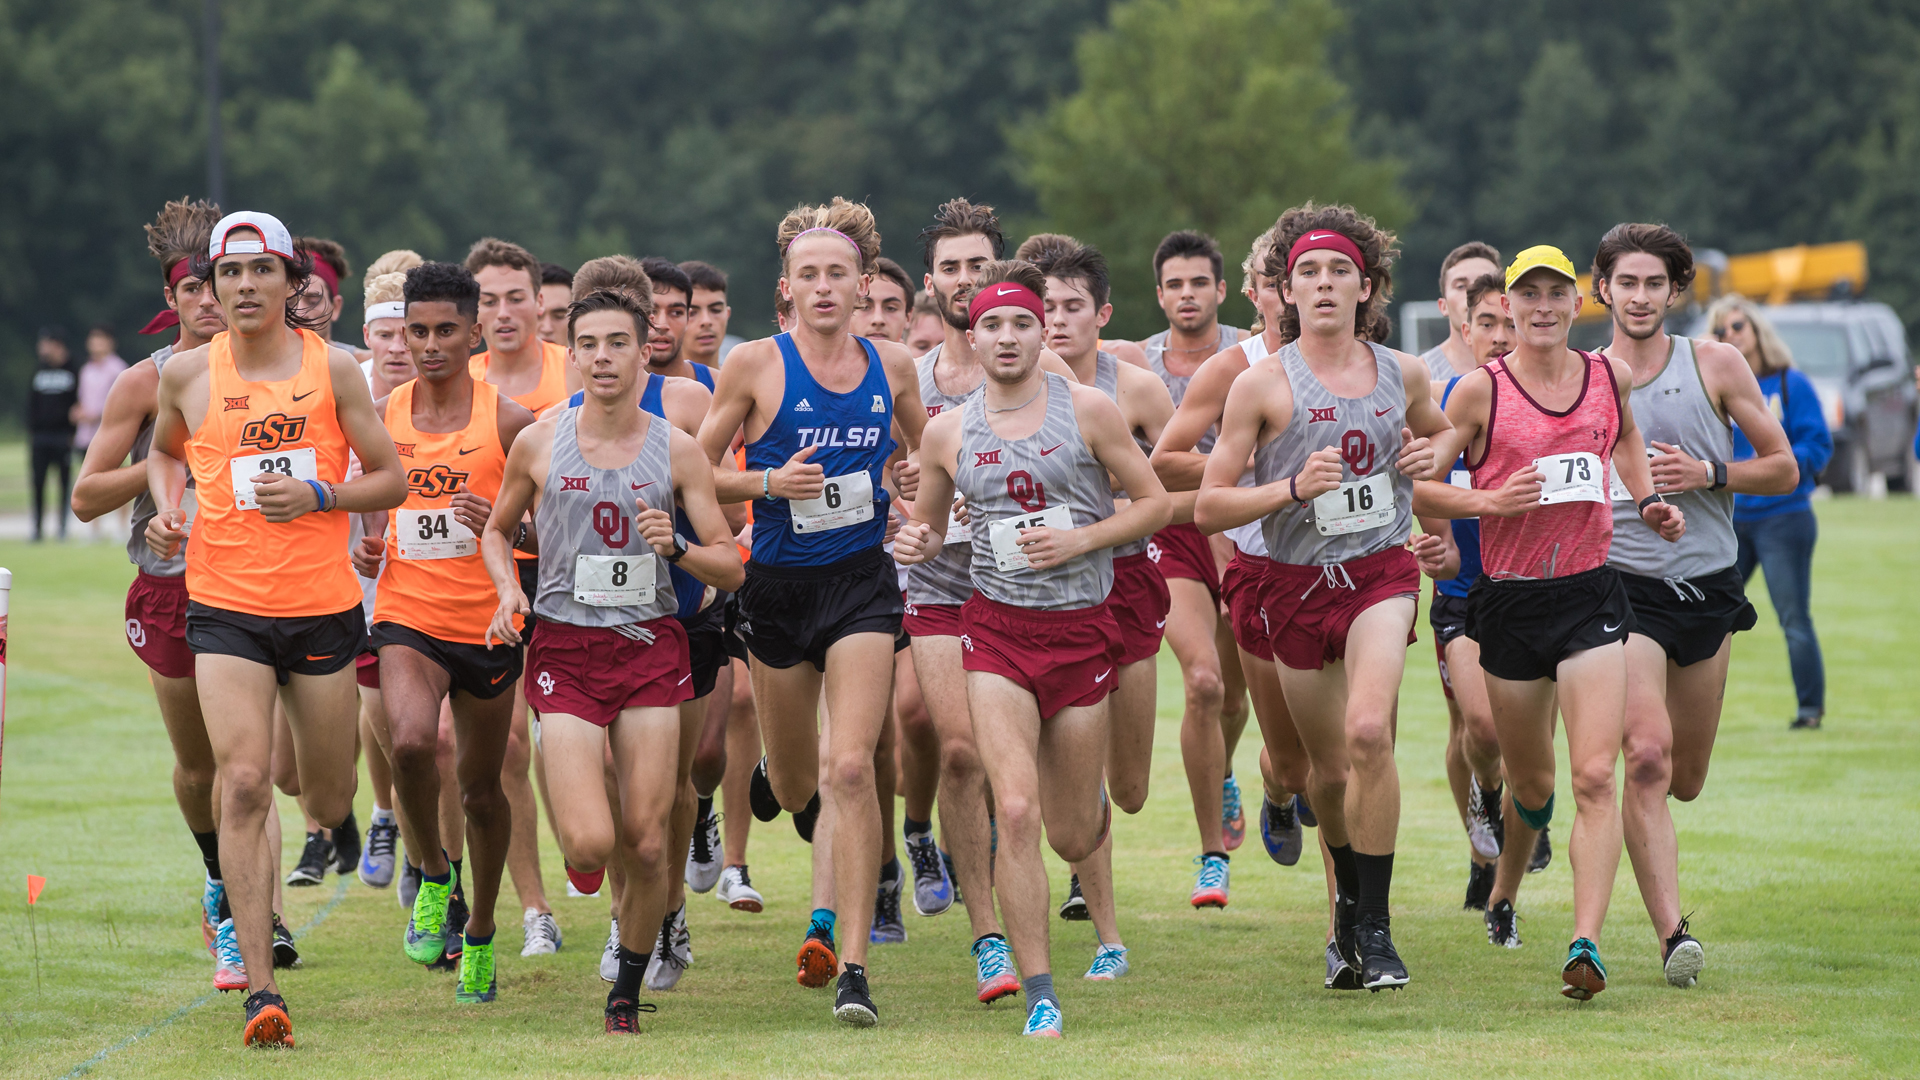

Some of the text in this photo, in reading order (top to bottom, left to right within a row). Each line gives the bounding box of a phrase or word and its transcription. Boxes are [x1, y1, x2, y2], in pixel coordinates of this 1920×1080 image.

[1308, 406, 1338, 424] XII
[240, 413, 308, 451] OSU
[798, 427, 881, 448] TULSA
[974, 449, 1002, 468] XII
[1342, 430, 1375, 476] OU
[407, 465, 469, 498] OSU
[560, 476, 590, 492] XII
[1560, 457, 1591, 484] 73
[825, 483, 841, 509] 6
[1006, 470, 1046, 513] OU
[1343, 484, 1373, 512] 16
[417, 514, 449, 540] 34
[593, 502, 629, 548] OU
[612, 561, 628, 586] 8
[126, 619, 146, 647] OU
